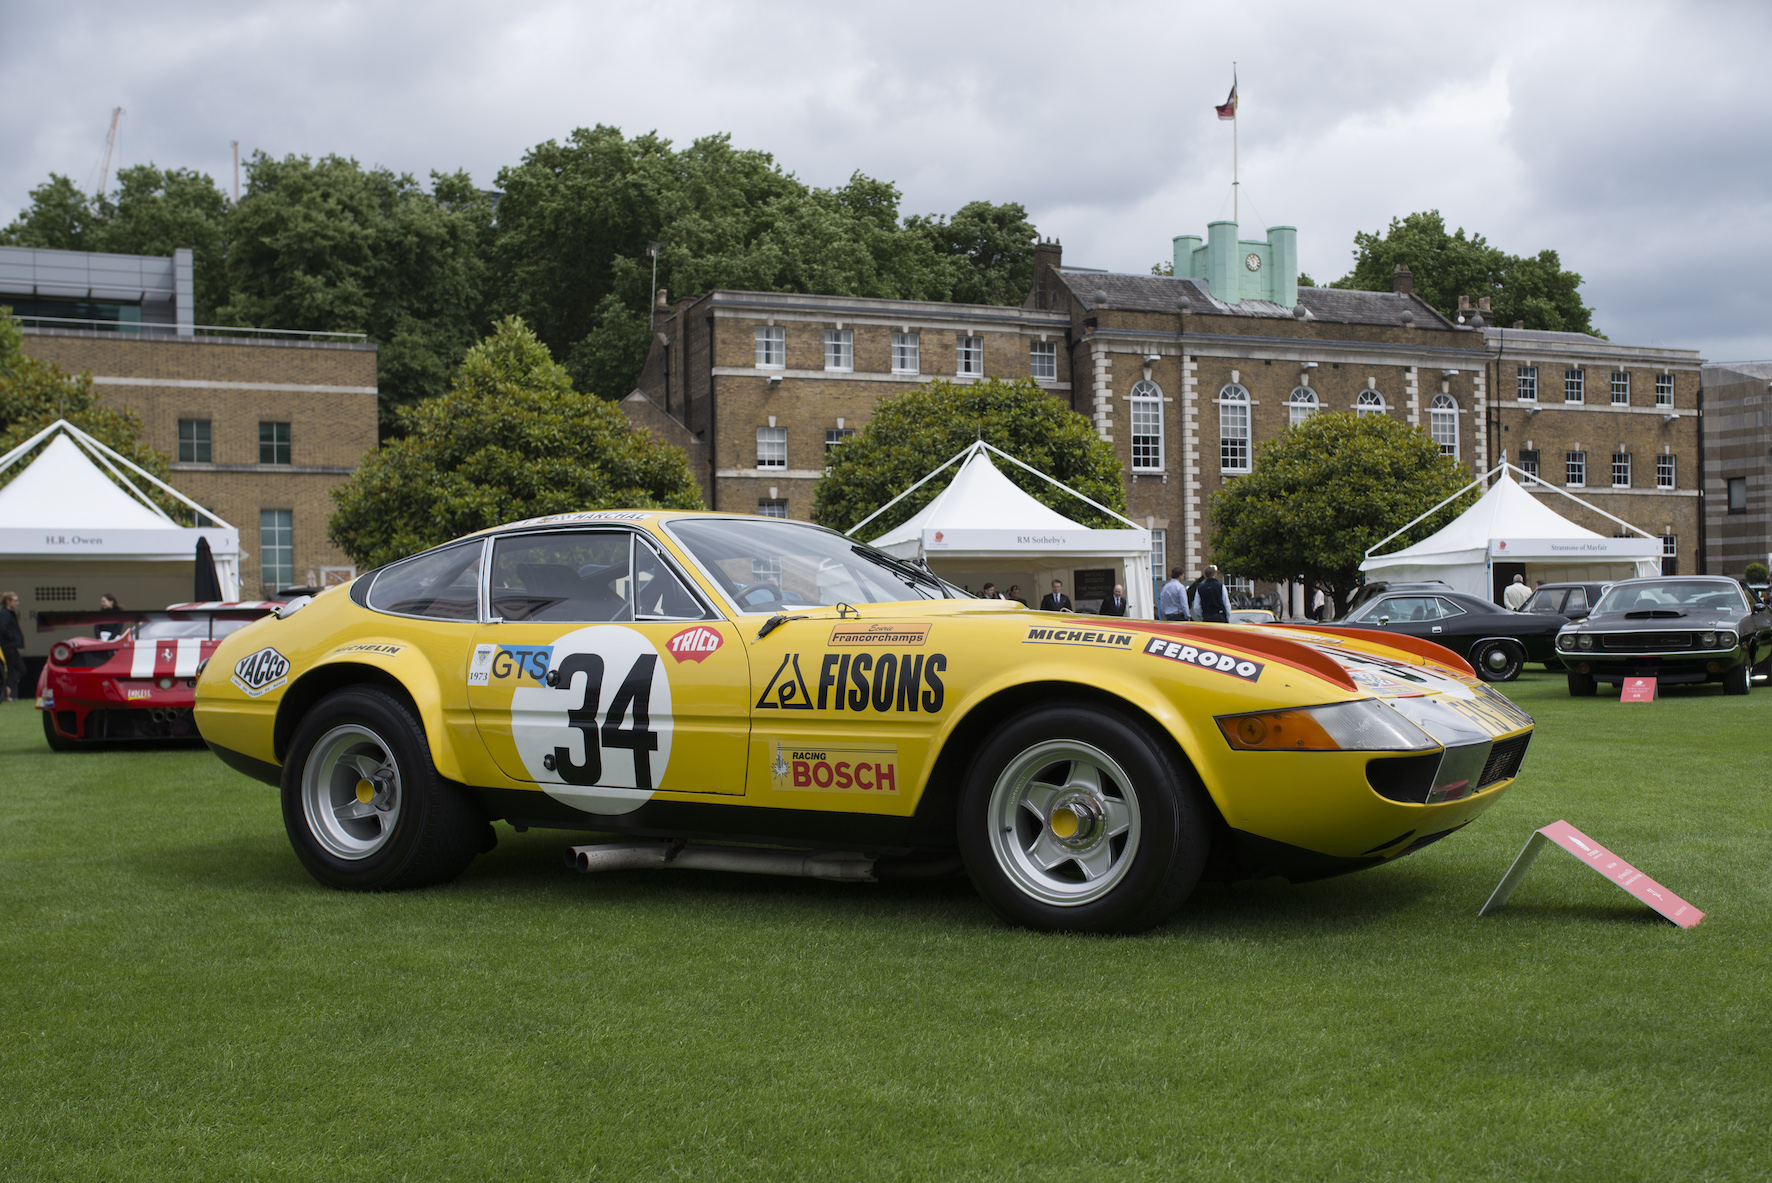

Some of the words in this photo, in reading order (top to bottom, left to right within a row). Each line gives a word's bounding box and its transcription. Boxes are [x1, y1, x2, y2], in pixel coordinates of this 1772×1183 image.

[573, 512, 645, 520] MARCHAL
[46, 536, 69, 545] H.R.
[71, 536, 103, 545] Owen
[1017, 536, 1031, 544] RM
[1031, 536, 1066, 546] Sotheby's
[1586, 544, 1608, 553] Mayfair
[868, 624, 894, 632] Ecurie
[672, 628, 719, 651] TRICO
[832, 633, 924, 644] Francorchamps
[1028, 629, 1132, 646] MICHELIN
[492, 650, 549, 680] GTS
[1148, 639, 1257, 677] FERODO
[239, 650, 285, 685] YACCO
[470, 672, 488, 681] 1973
[817, 653, 947, 713] FISONS
[554, 653, 658, 789] 34
[792, 752, 826, 760] RACING
[792, 761, 895, 790] BOSCH
